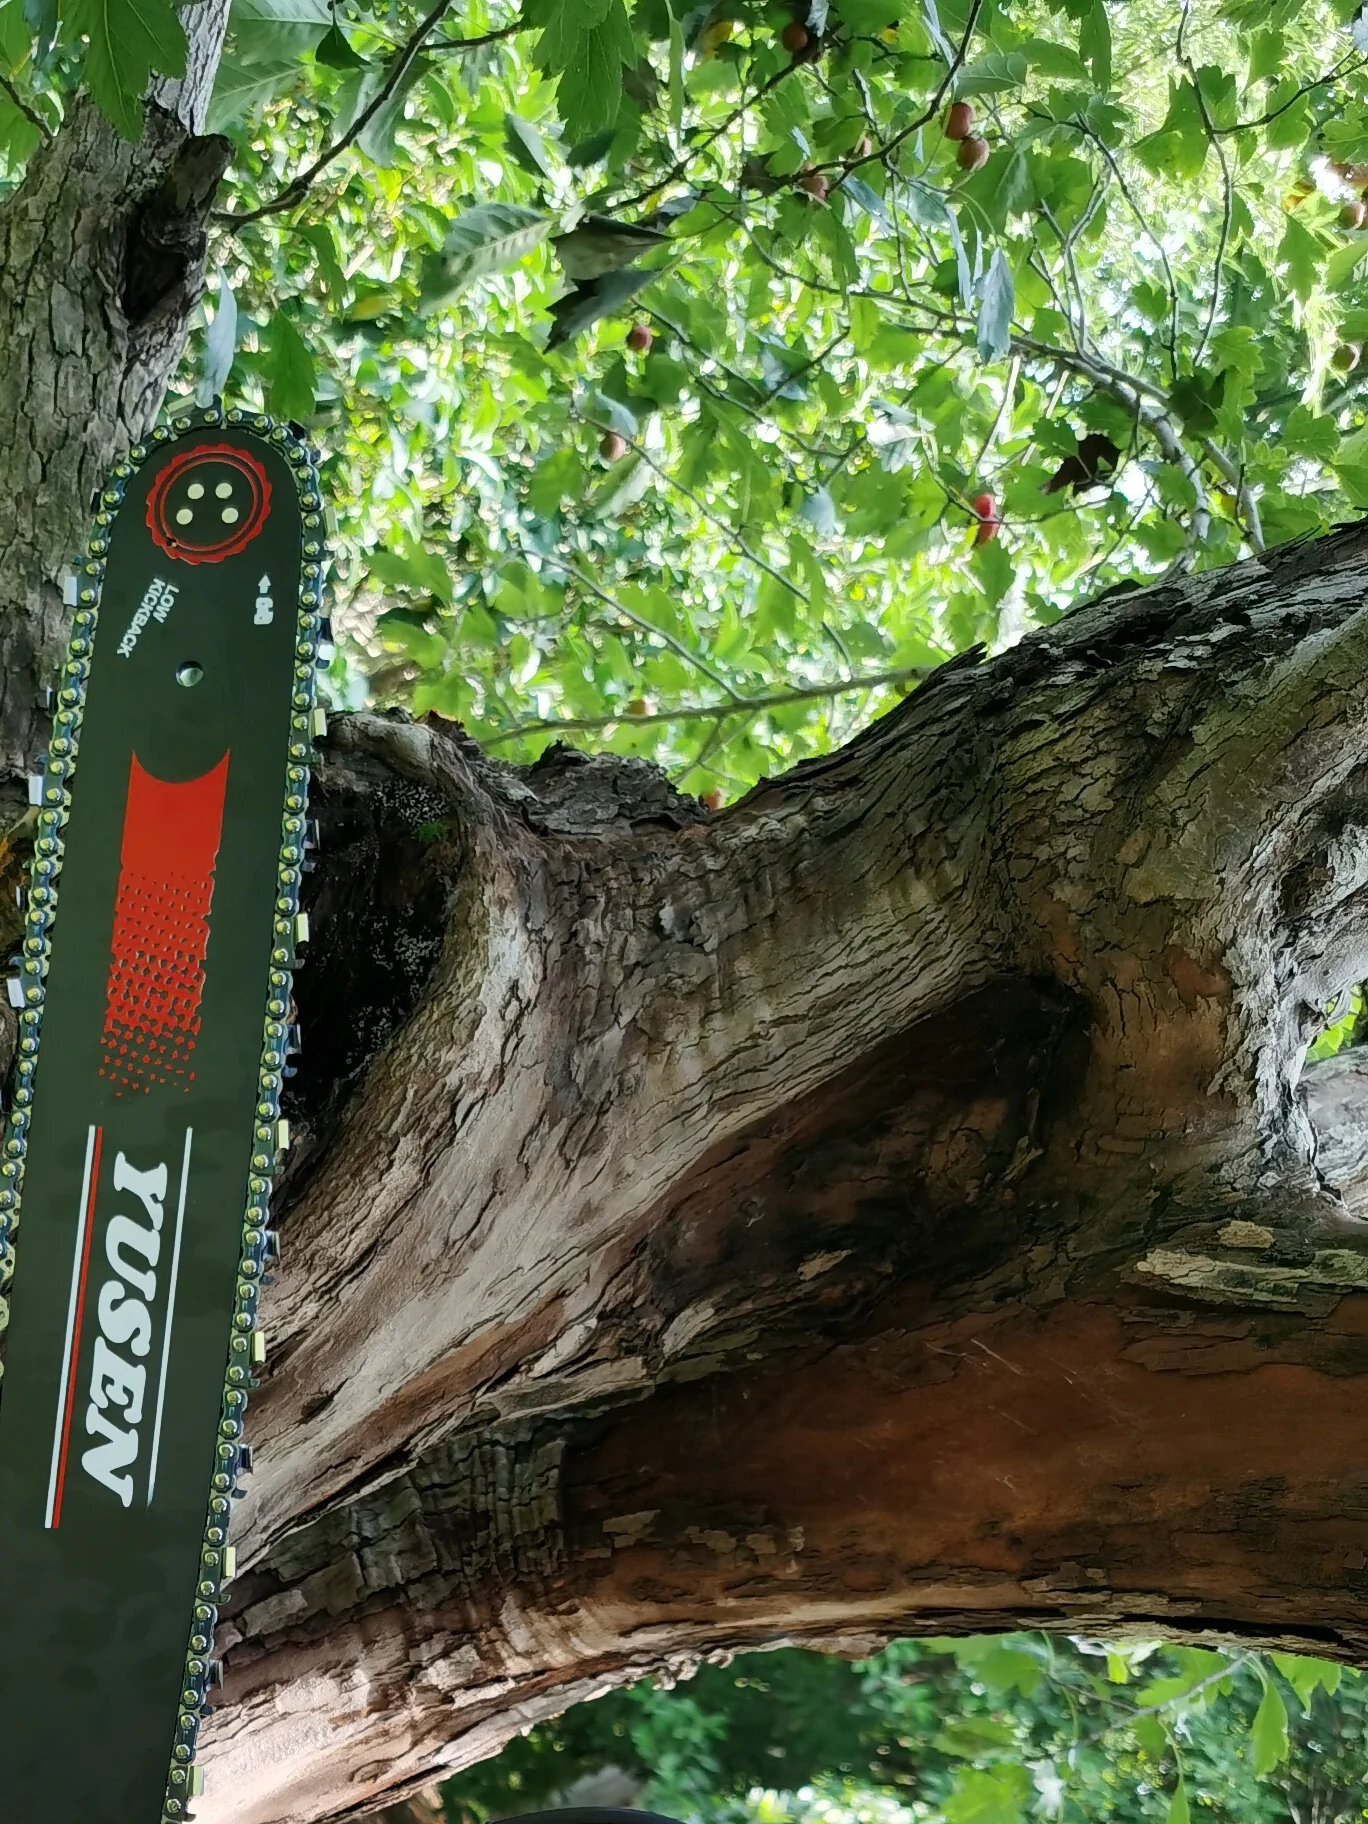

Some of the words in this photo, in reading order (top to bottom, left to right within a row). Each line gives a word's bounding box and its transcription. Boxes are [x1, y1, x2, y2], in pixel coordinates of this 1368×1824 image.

[116, 577, 164, 659] KICKBACK
[152, 584, 180, 624] LOW
[81, 1151, 168, 1508] YUSEN
